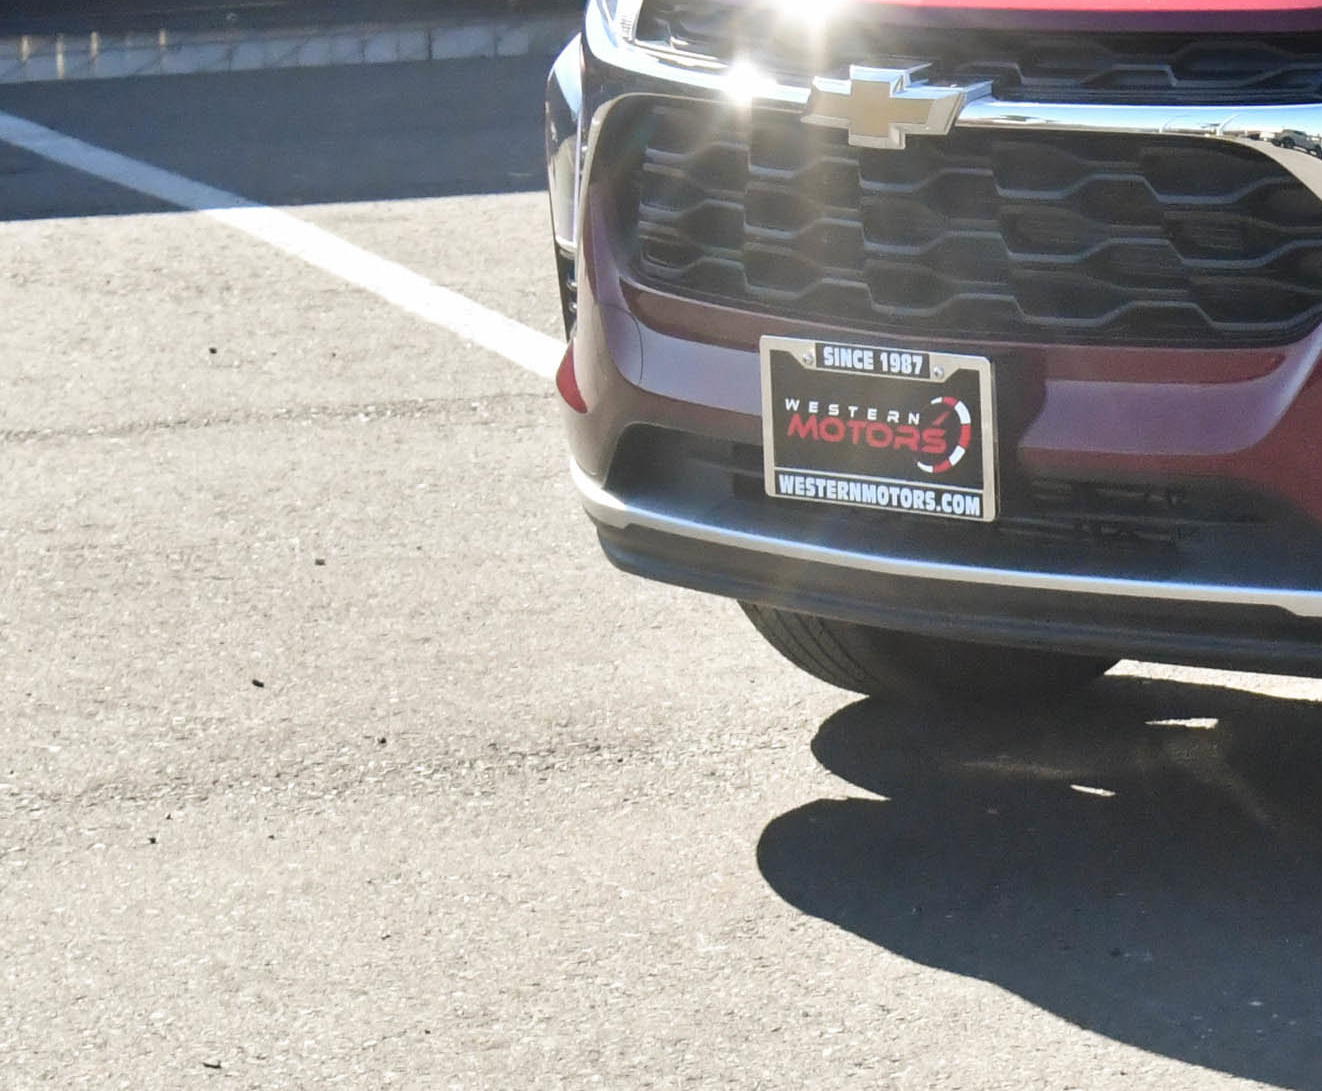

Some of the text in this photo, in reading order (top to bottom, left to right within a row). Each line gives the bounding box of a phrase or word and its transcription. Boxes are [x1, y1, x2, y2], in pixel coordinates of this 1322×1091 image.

[823, 347, 923, 375] SINCE 1987
[784, 398, 920, 425] WESTERN
[787, 414, 948, 454] MOTORS
[778, 474, 981, 516] WESTERNMOTORS.COM
